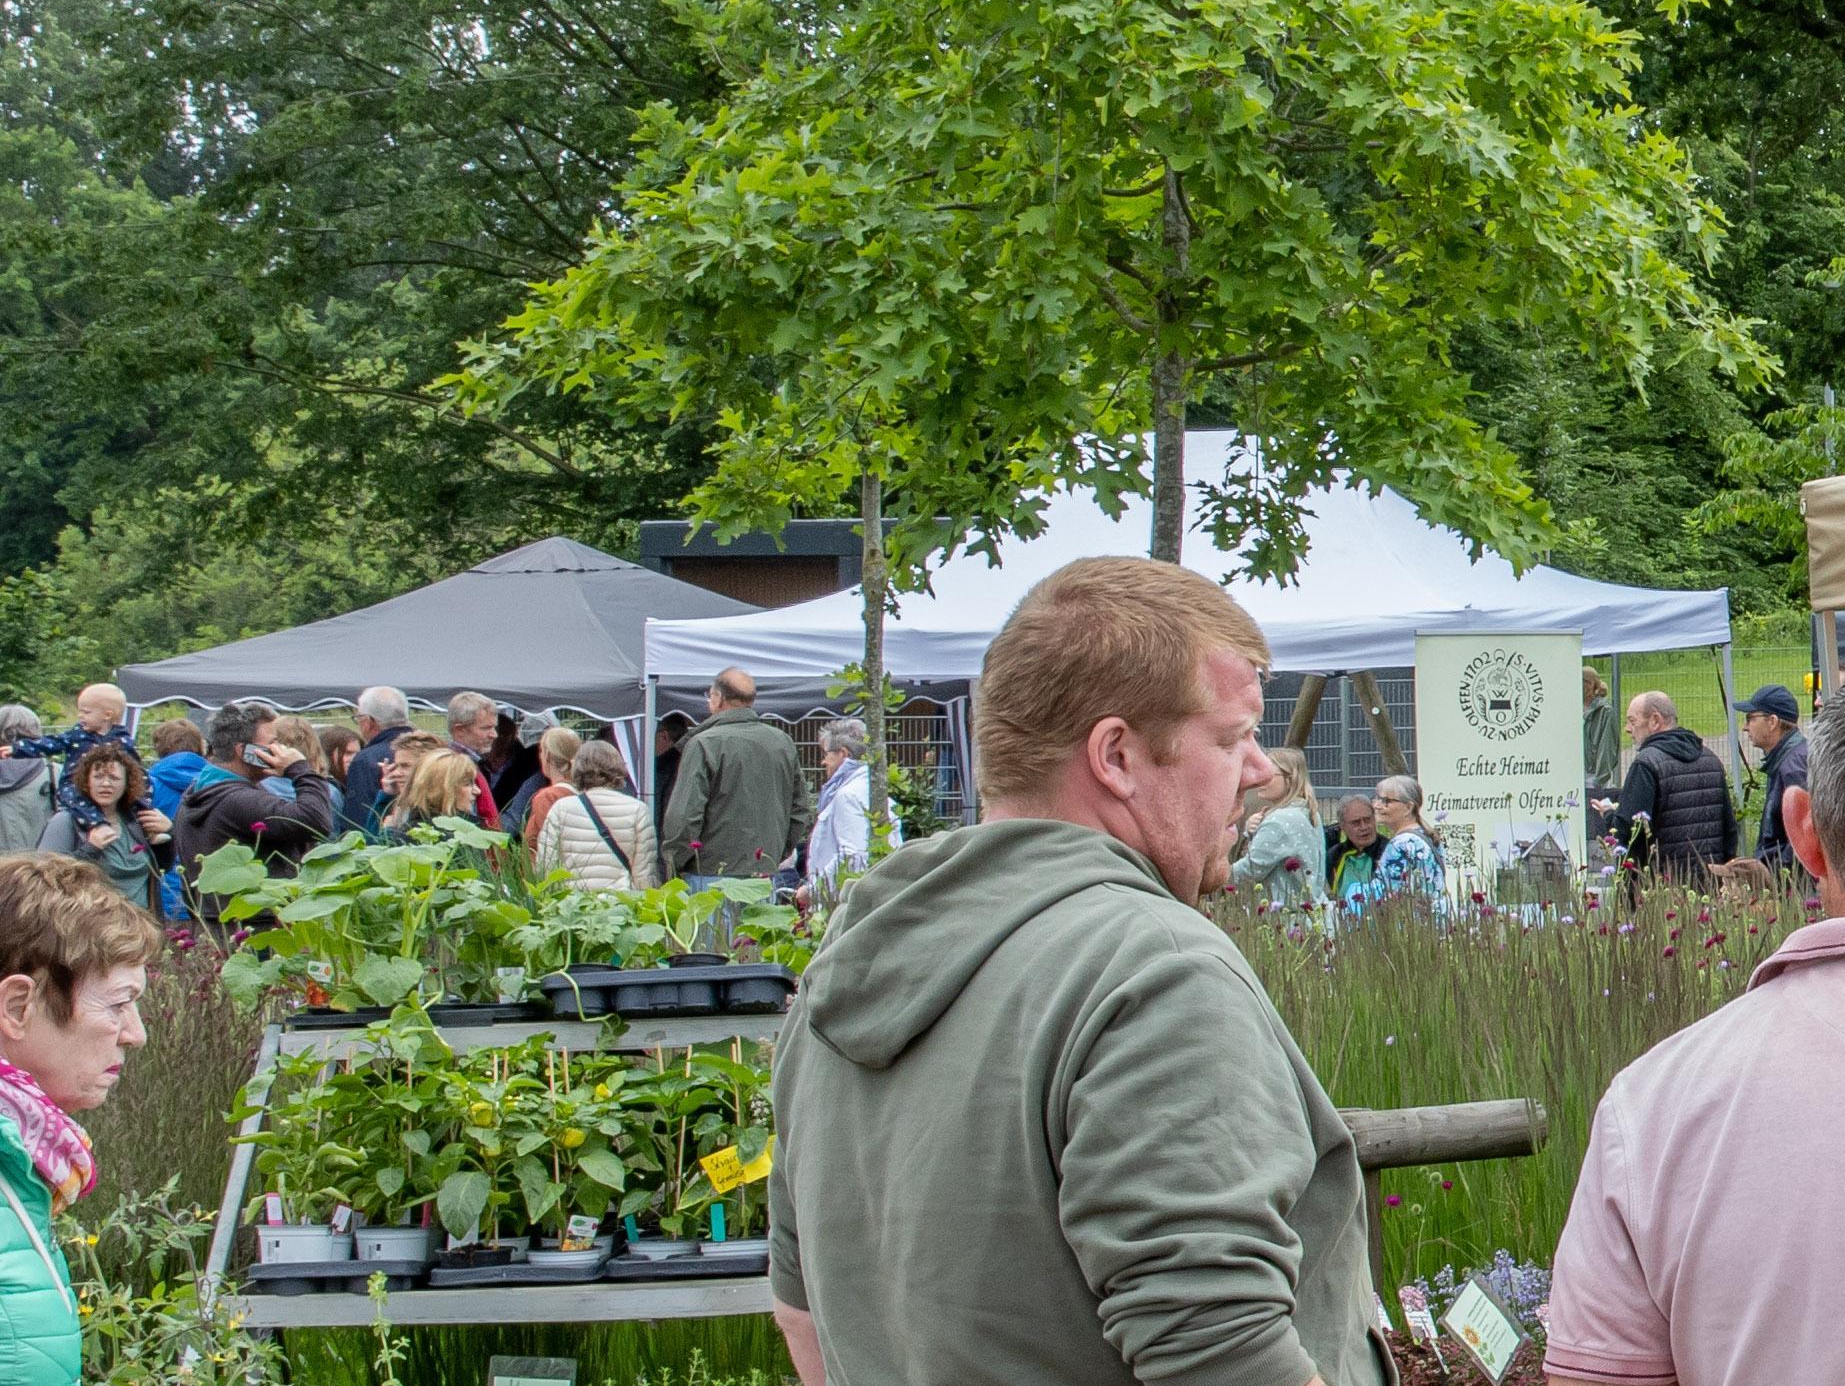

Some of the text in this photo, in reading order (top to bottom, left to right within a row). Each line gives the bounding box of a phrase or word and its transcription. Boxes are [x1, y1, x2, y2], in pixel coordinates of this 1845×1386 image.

[1456, 754, 1551, 776] Echte Heimat
[1427, 792, 1511, 812] Heimatverein
[1519, 788, 1553, 815] Olfen
